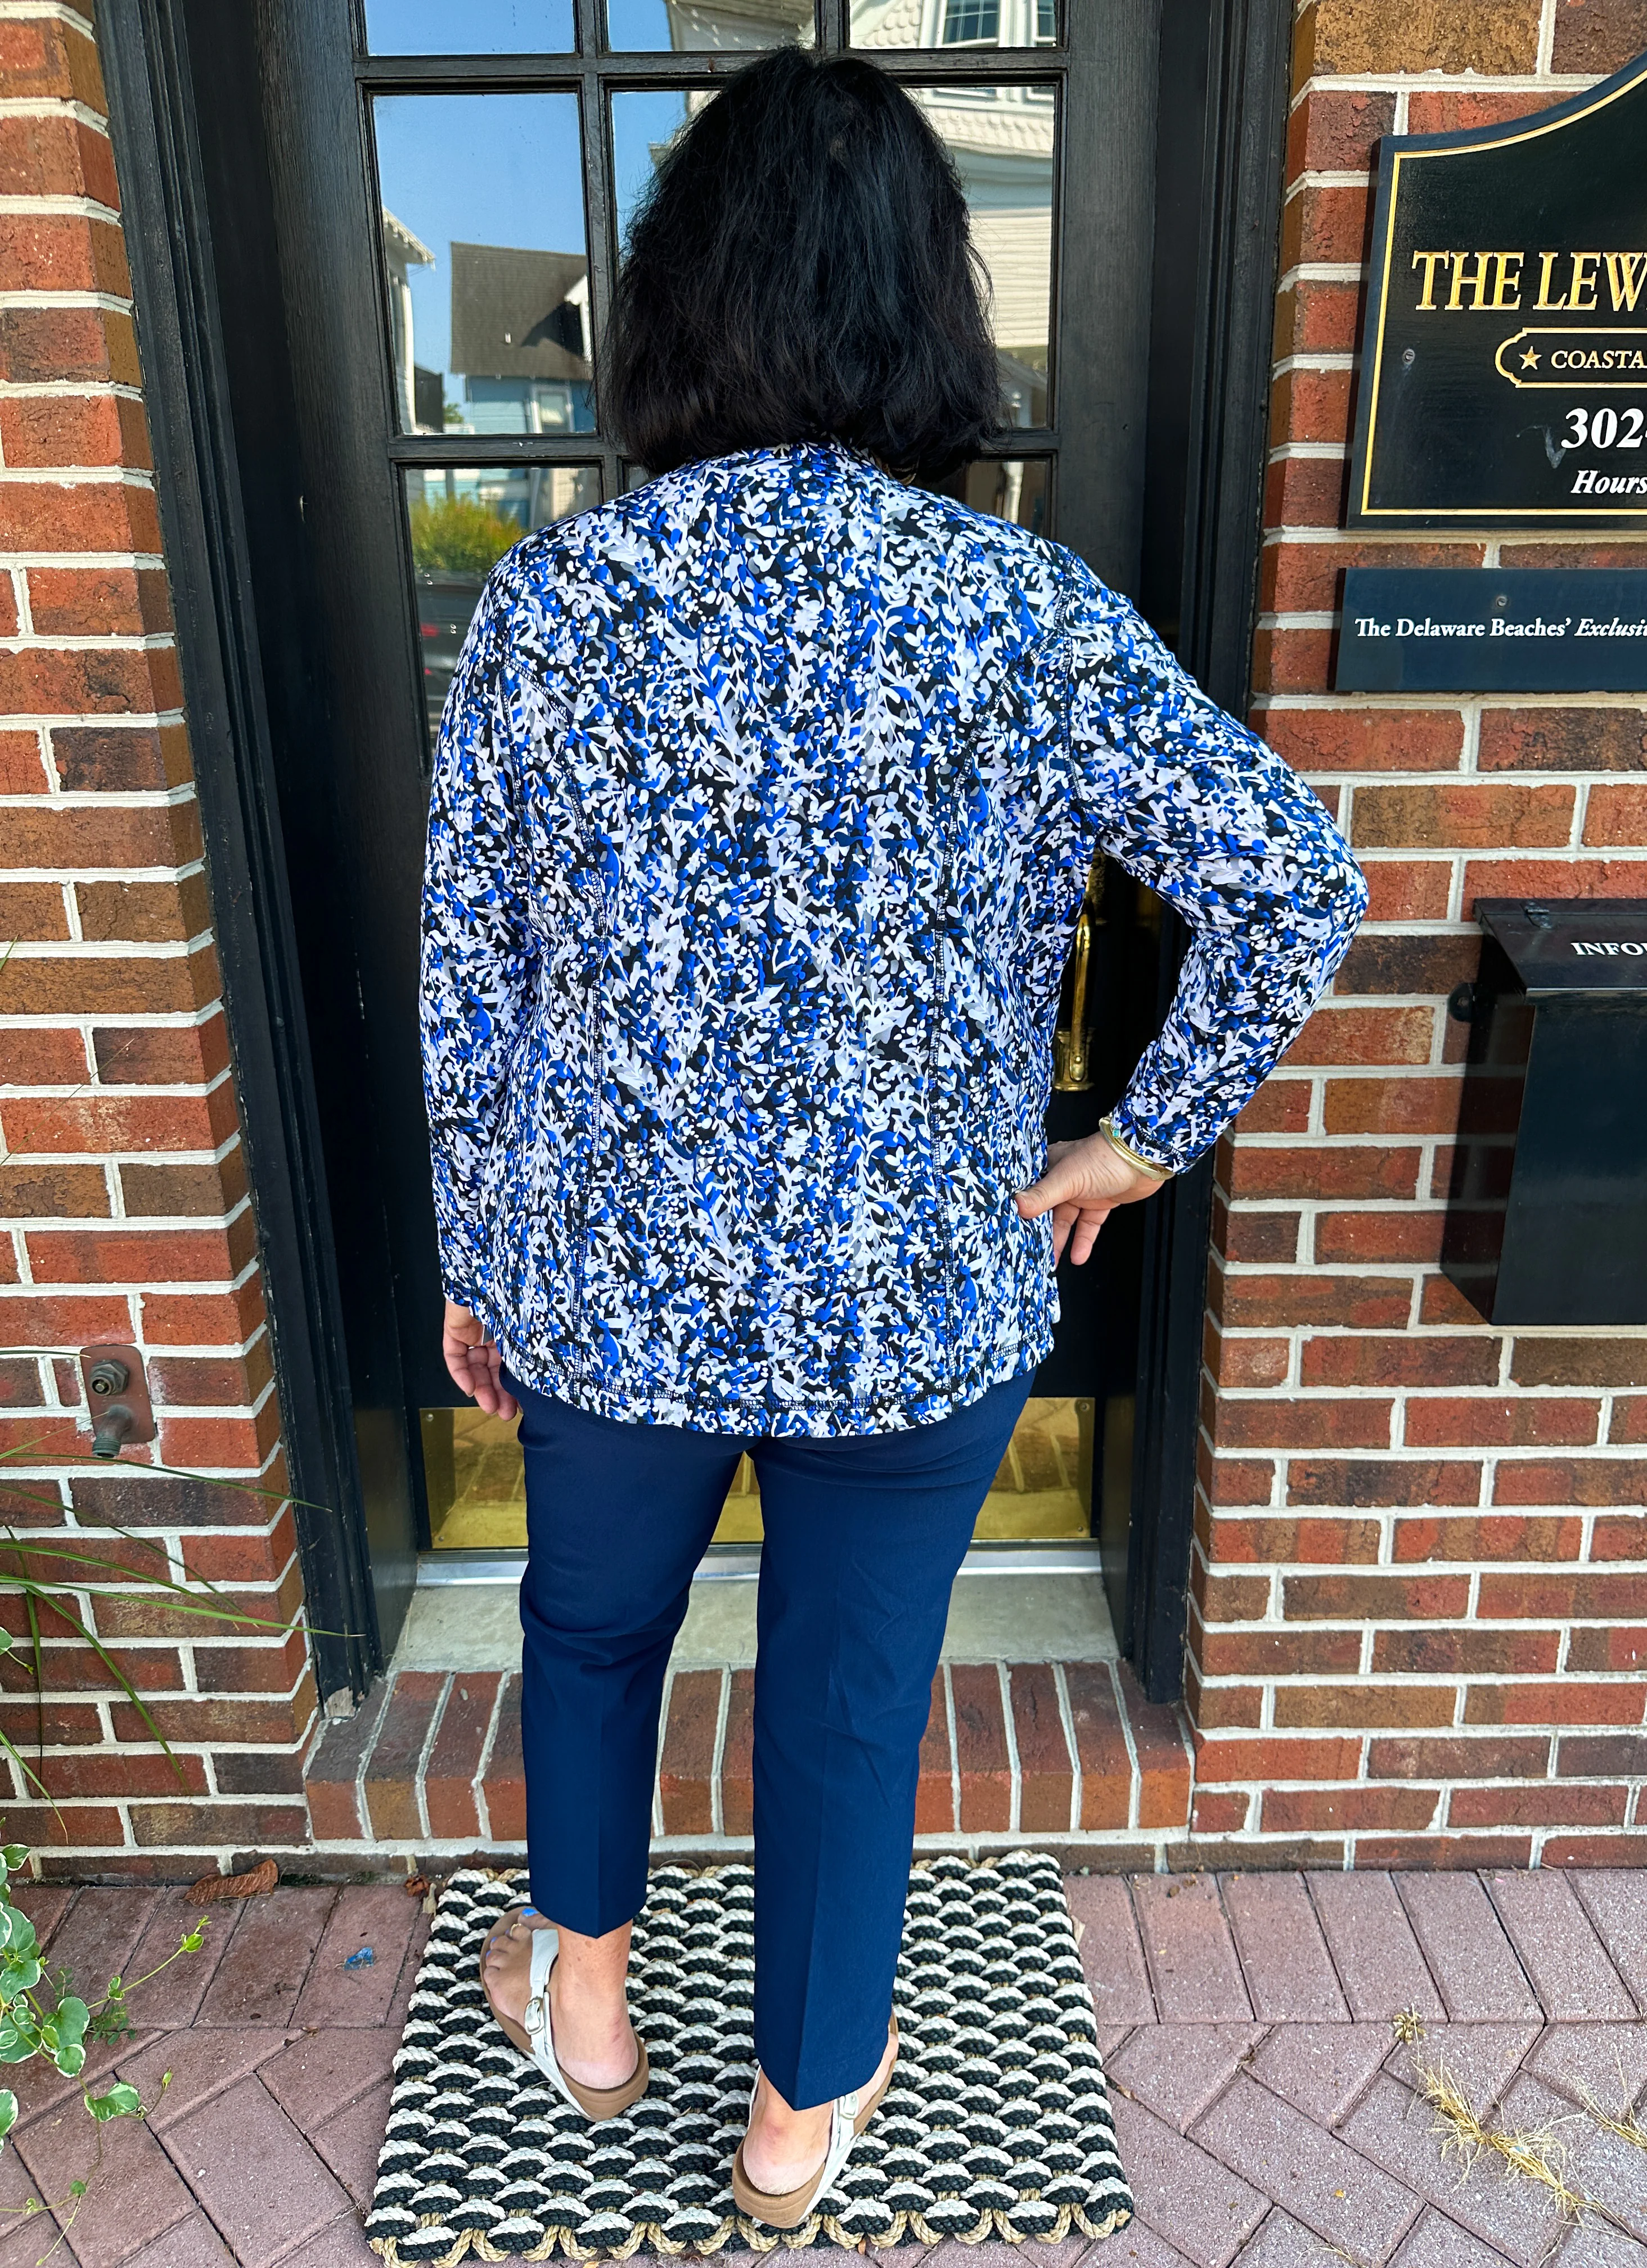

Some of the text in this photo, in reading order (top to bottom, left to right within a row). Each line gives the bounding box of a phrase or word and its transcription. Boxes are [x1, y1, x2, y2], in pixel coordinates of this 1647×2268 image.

[1411, 250, 1647, 312] THE LEW
[1551, 350, 1647, 369] COASTA
[1561, 408, 1647, 448] 302
[1570, 470, 1647, 494] Hours
[1355, 617, 1391, 637] The
[1396, 617, 1486, 637] Delaware
[1489, 617, 1572, 637] Beaches’
